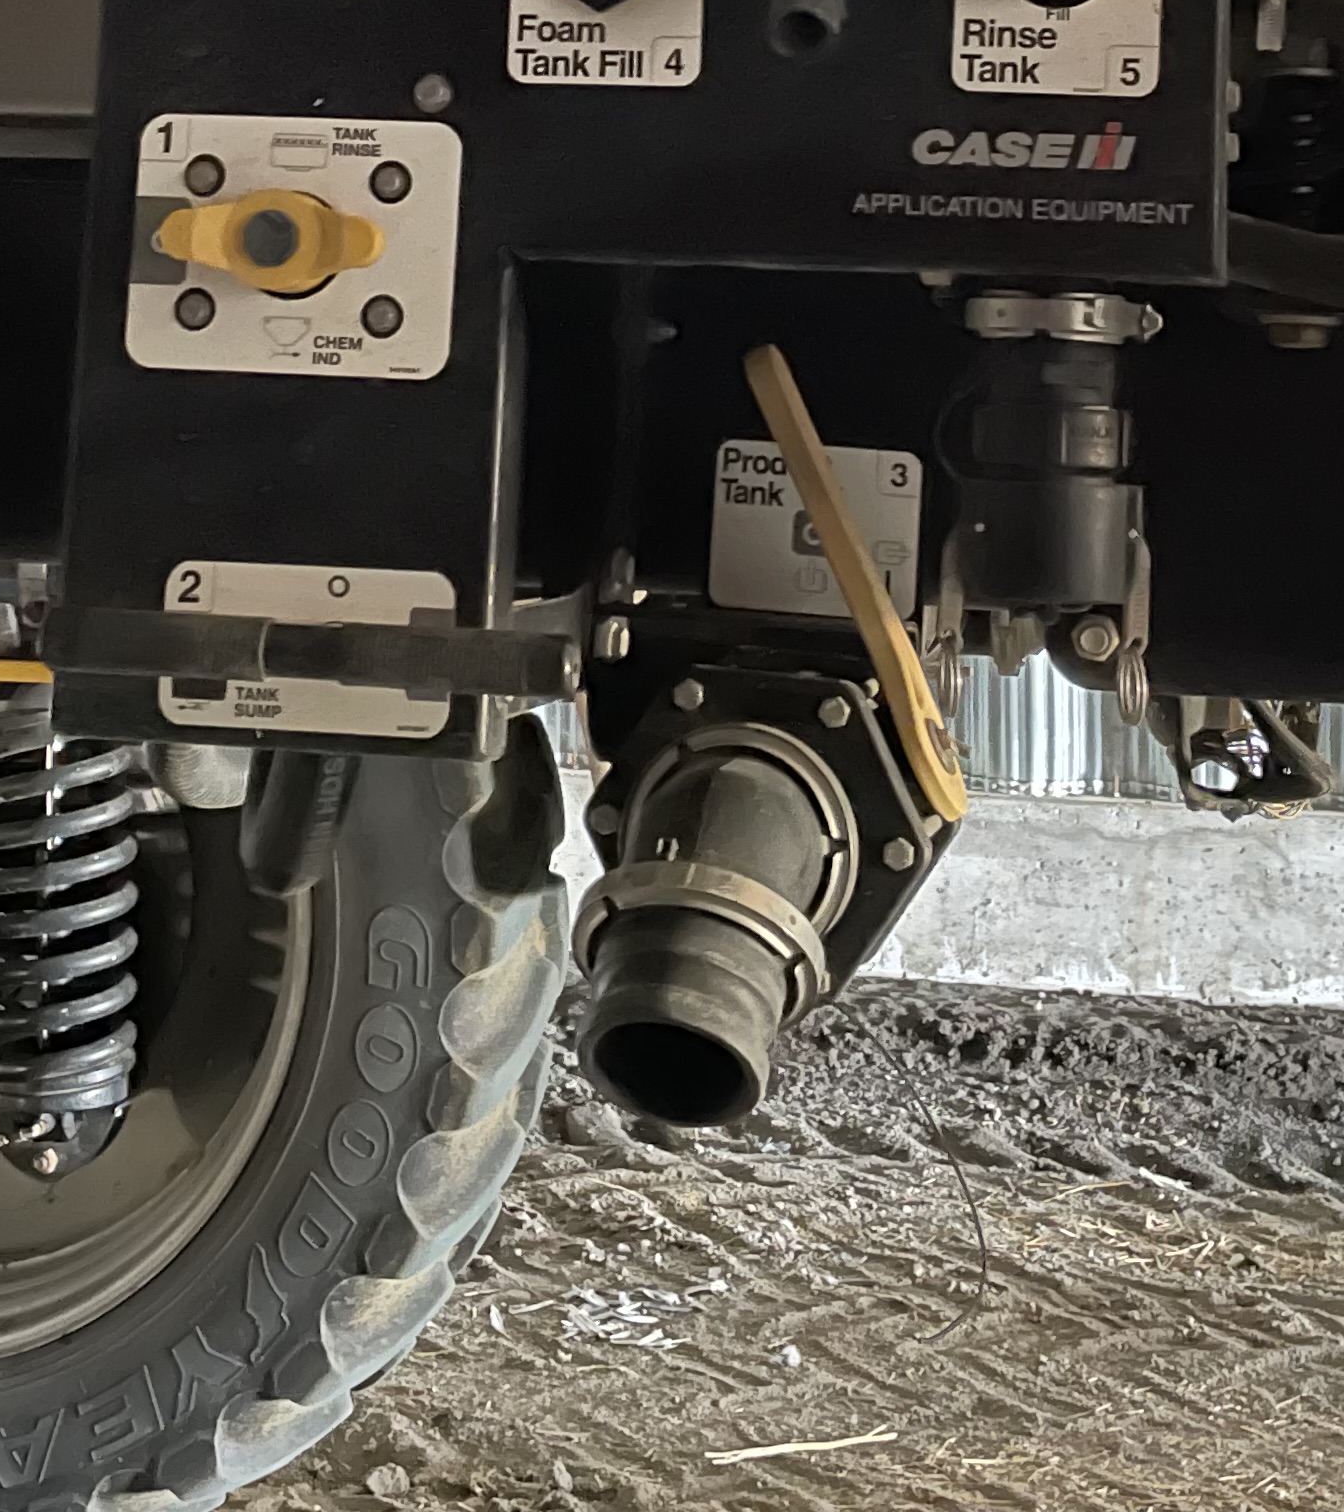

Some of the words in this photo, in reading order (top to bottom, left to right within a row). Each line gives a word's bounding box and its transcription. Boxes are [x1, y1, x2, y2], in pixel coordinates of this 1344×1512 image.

[1046, 6, 1070, 21] Fill
[517, 14, 606, 43] Foam
[962, 18, 1058, 49] Rinse
[514, 48, 591, 78] Tank
[598, 49, 644, 79] Fill
[664, 48, 685, 76] 4
[959, 53, 1041, 84] Tank
[1119, 57, 1141, 86] 5
[156, 121, 174, 153] 1
[332, 127, 378, 143] TANK
[911, 128, 1076, 169] CASE
[331, 143, 383, 158] RINSE
[851, 192, 1024, 219] APPLICATION
[1031, 198, 1195, 225] EQUIPMENT
[312, 335, 364, 351] CHEM
[311, 351, 342, 366] IND
[889, 463, 908, 488] 3
[720, 477, 785, 507] Tank
[177, 569, 202, 604] 2
[234, 686, 280, 703] TANK
[233, 703, 283, 719] SUMP
